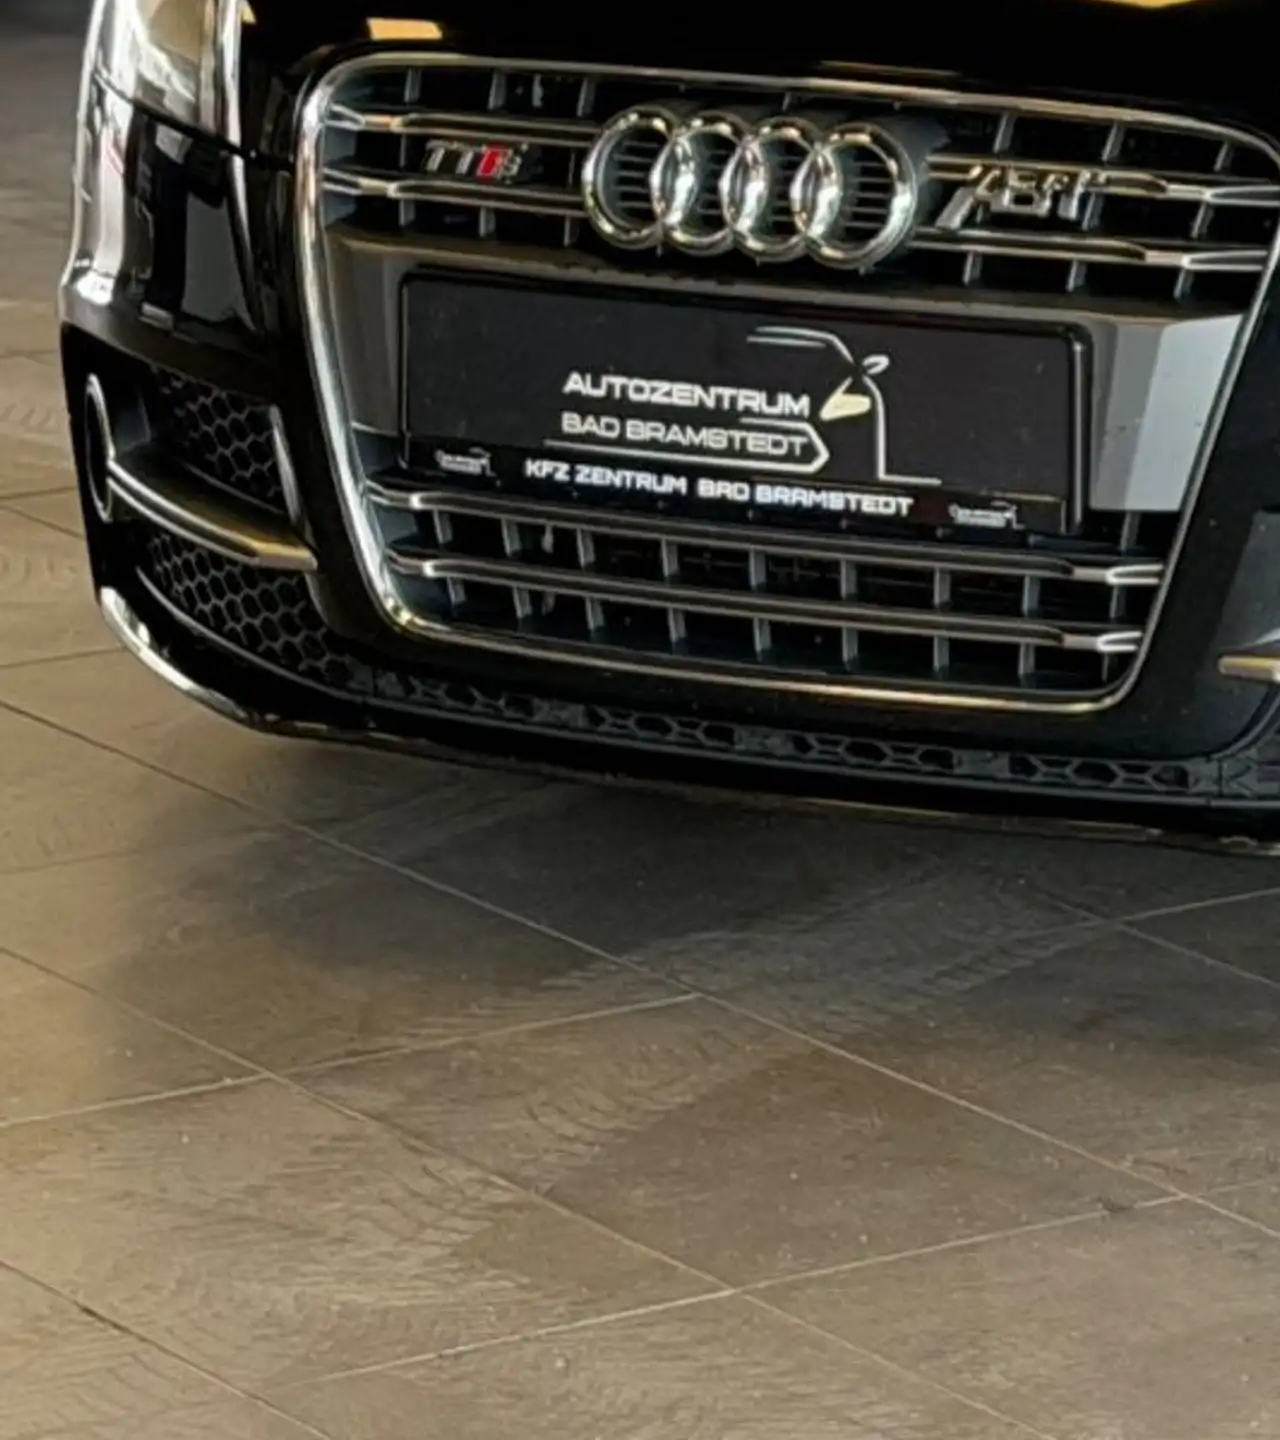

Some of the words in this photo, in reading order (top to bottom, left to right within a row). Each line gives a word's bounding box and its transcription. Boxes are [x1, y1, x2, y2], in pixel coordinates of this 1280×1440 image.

[563, 372, 811, 418] AUTOZENTRUM
[561, 412, 621, 439] BAD
[626, 416, 810, 456] BRAMSTEDT
[525, 458, 570, 482] KFZ
[574, 464, 688, 495] ZENTRUM
[697, 477, 750, 502] BAD
[754, 482, 914, 517] BRAMSTEDT
